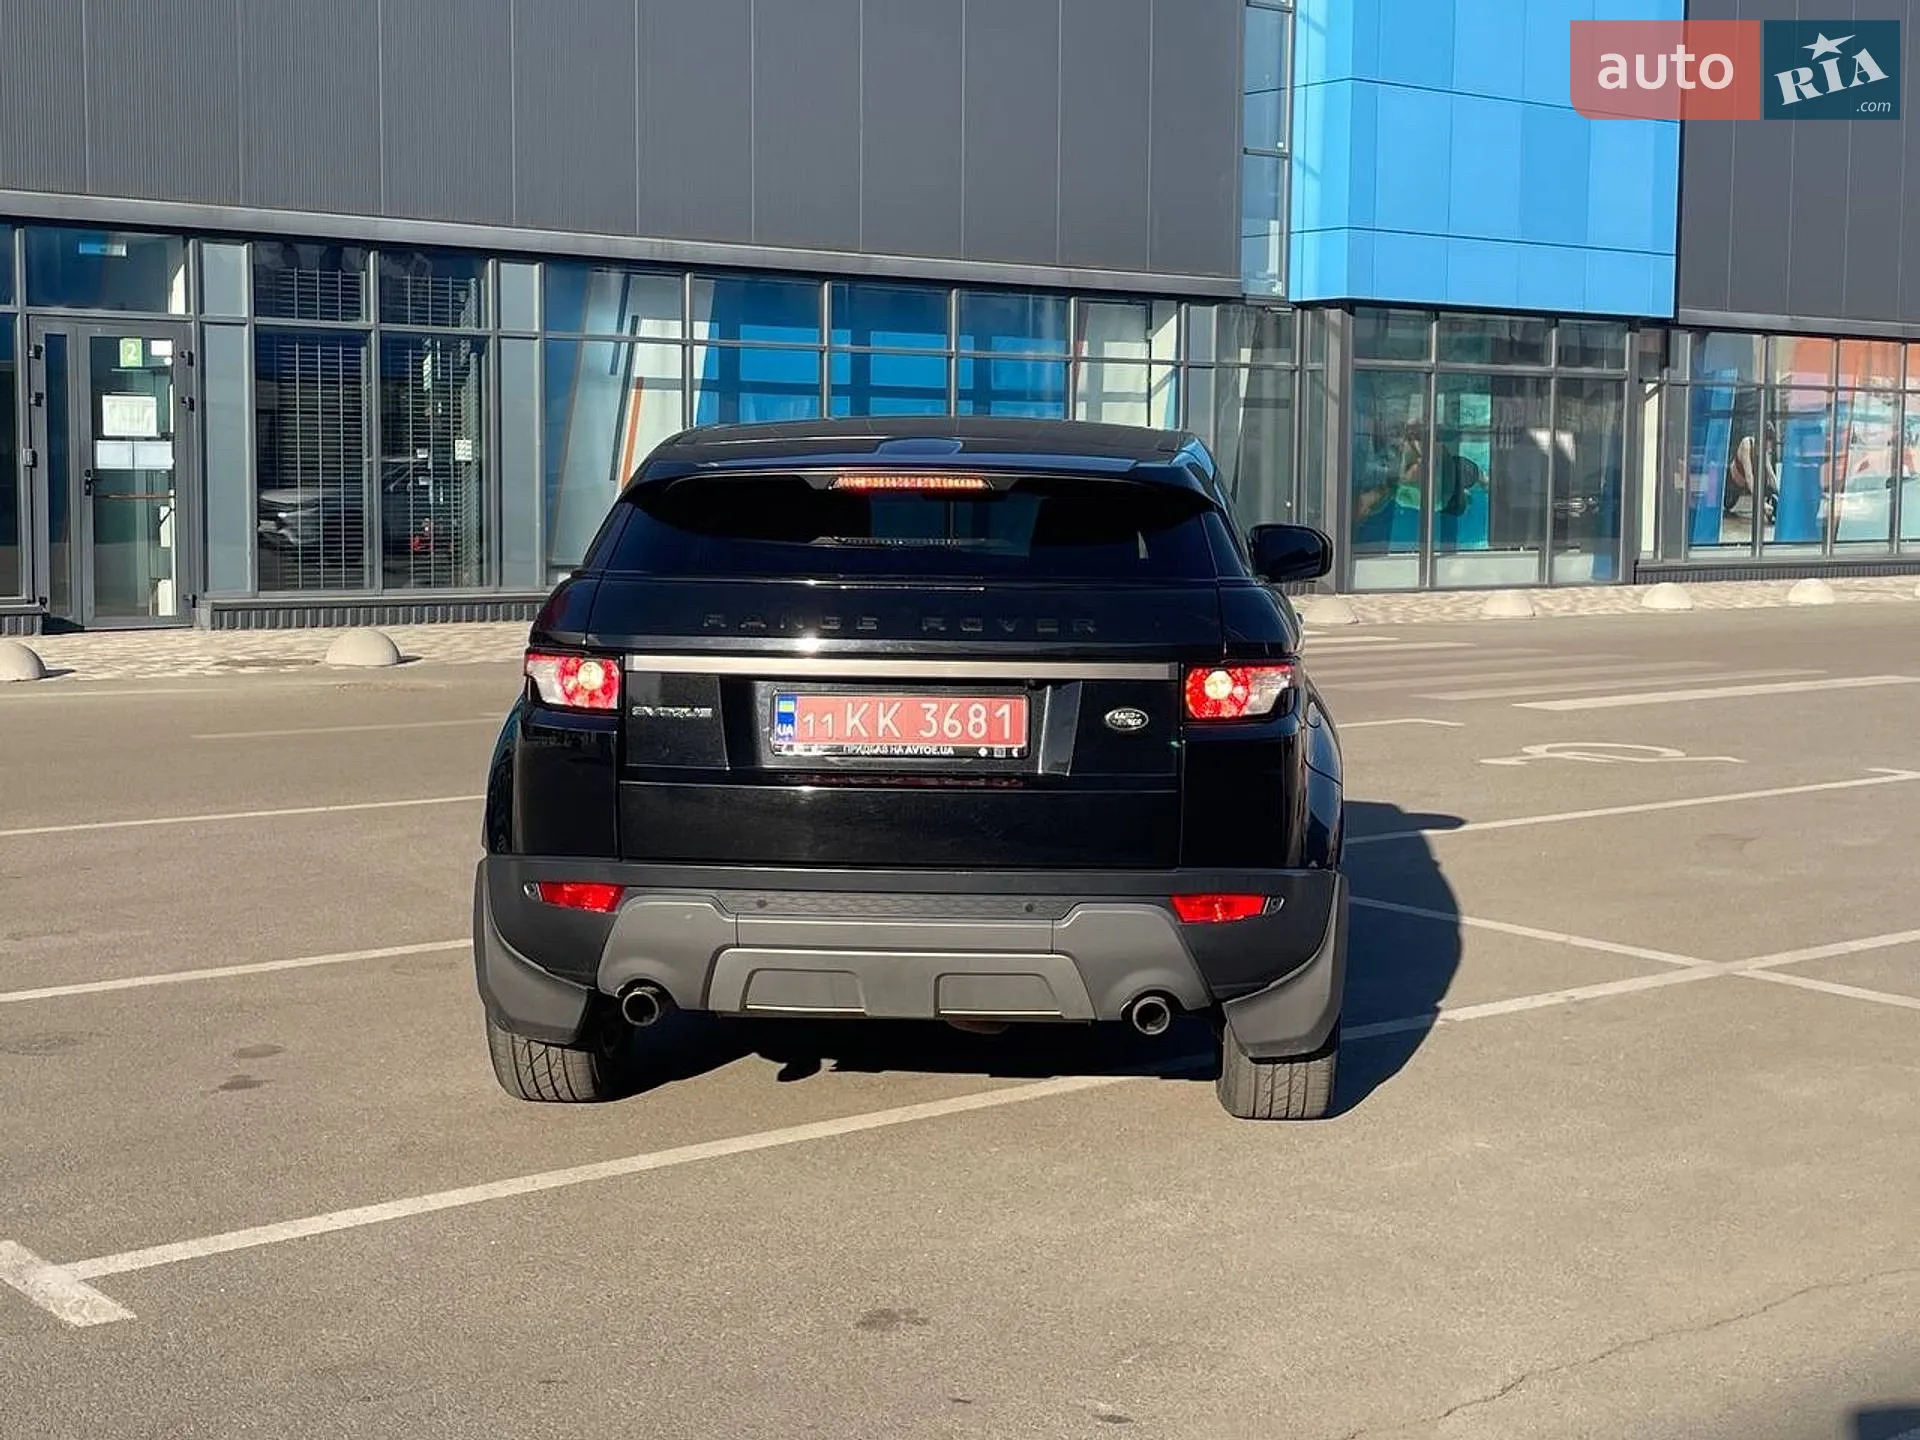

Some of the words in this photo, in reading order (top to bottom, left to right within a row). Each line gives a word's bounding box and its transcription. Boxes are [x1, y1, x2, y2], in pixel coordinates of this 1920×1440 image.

[122, 342, 138, 361] 2
[777, 723, 794, 736] UA
[802, 712, 834, 737] 11
[845, 701, 903, 738] KK
[918, 702, 1014, 739] 3681
